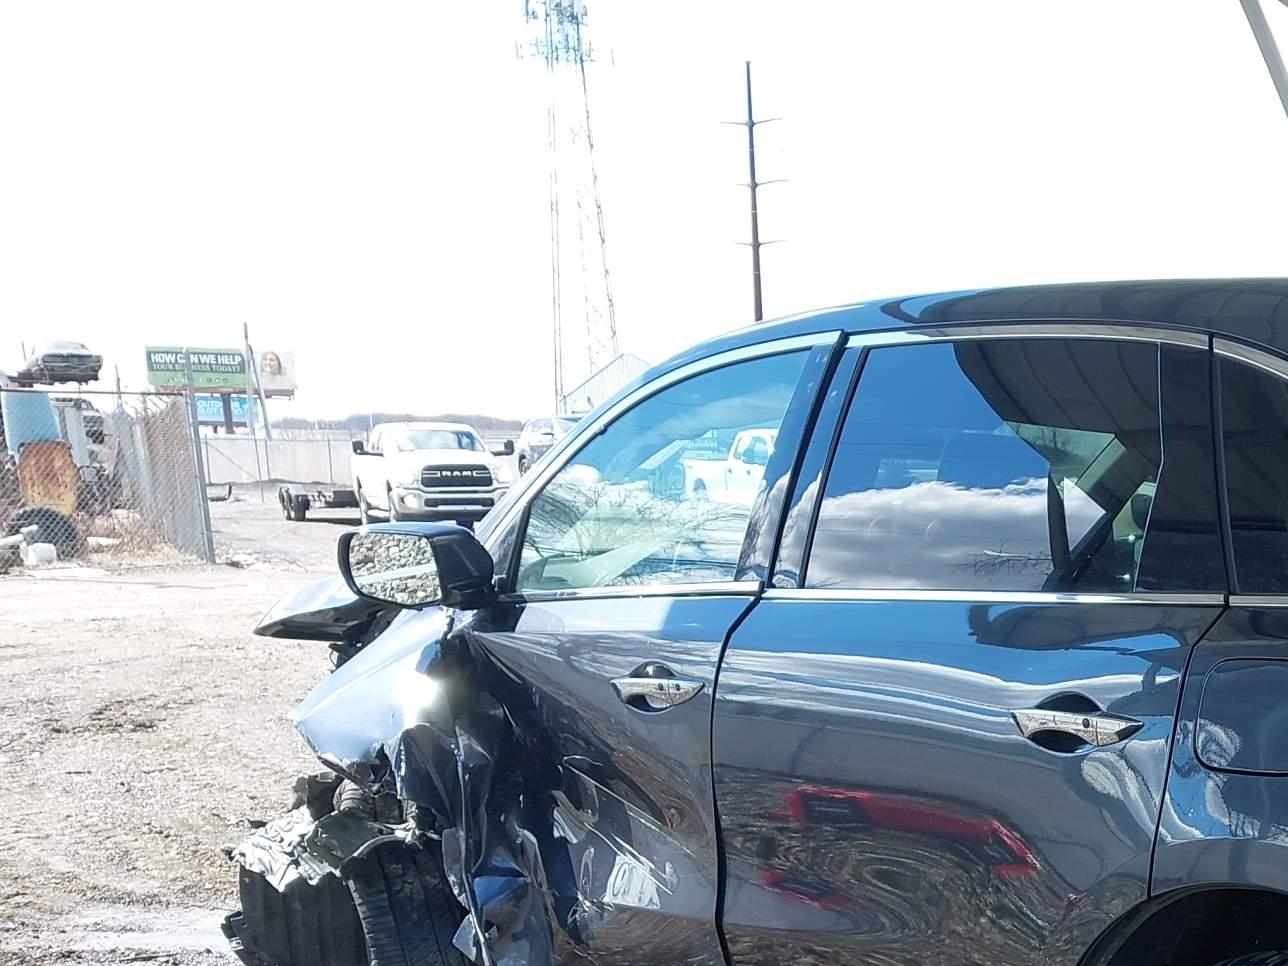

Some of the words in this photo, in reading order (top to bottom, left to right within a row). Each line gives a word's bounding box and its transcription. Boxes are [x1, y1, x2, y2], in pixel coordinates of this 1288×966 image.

[151, 352, 175, 363] HOW
[176, 353, 198, 363] CN
[198, 353, 217, 364] WE
[217, 354, 241, 365] HELP
